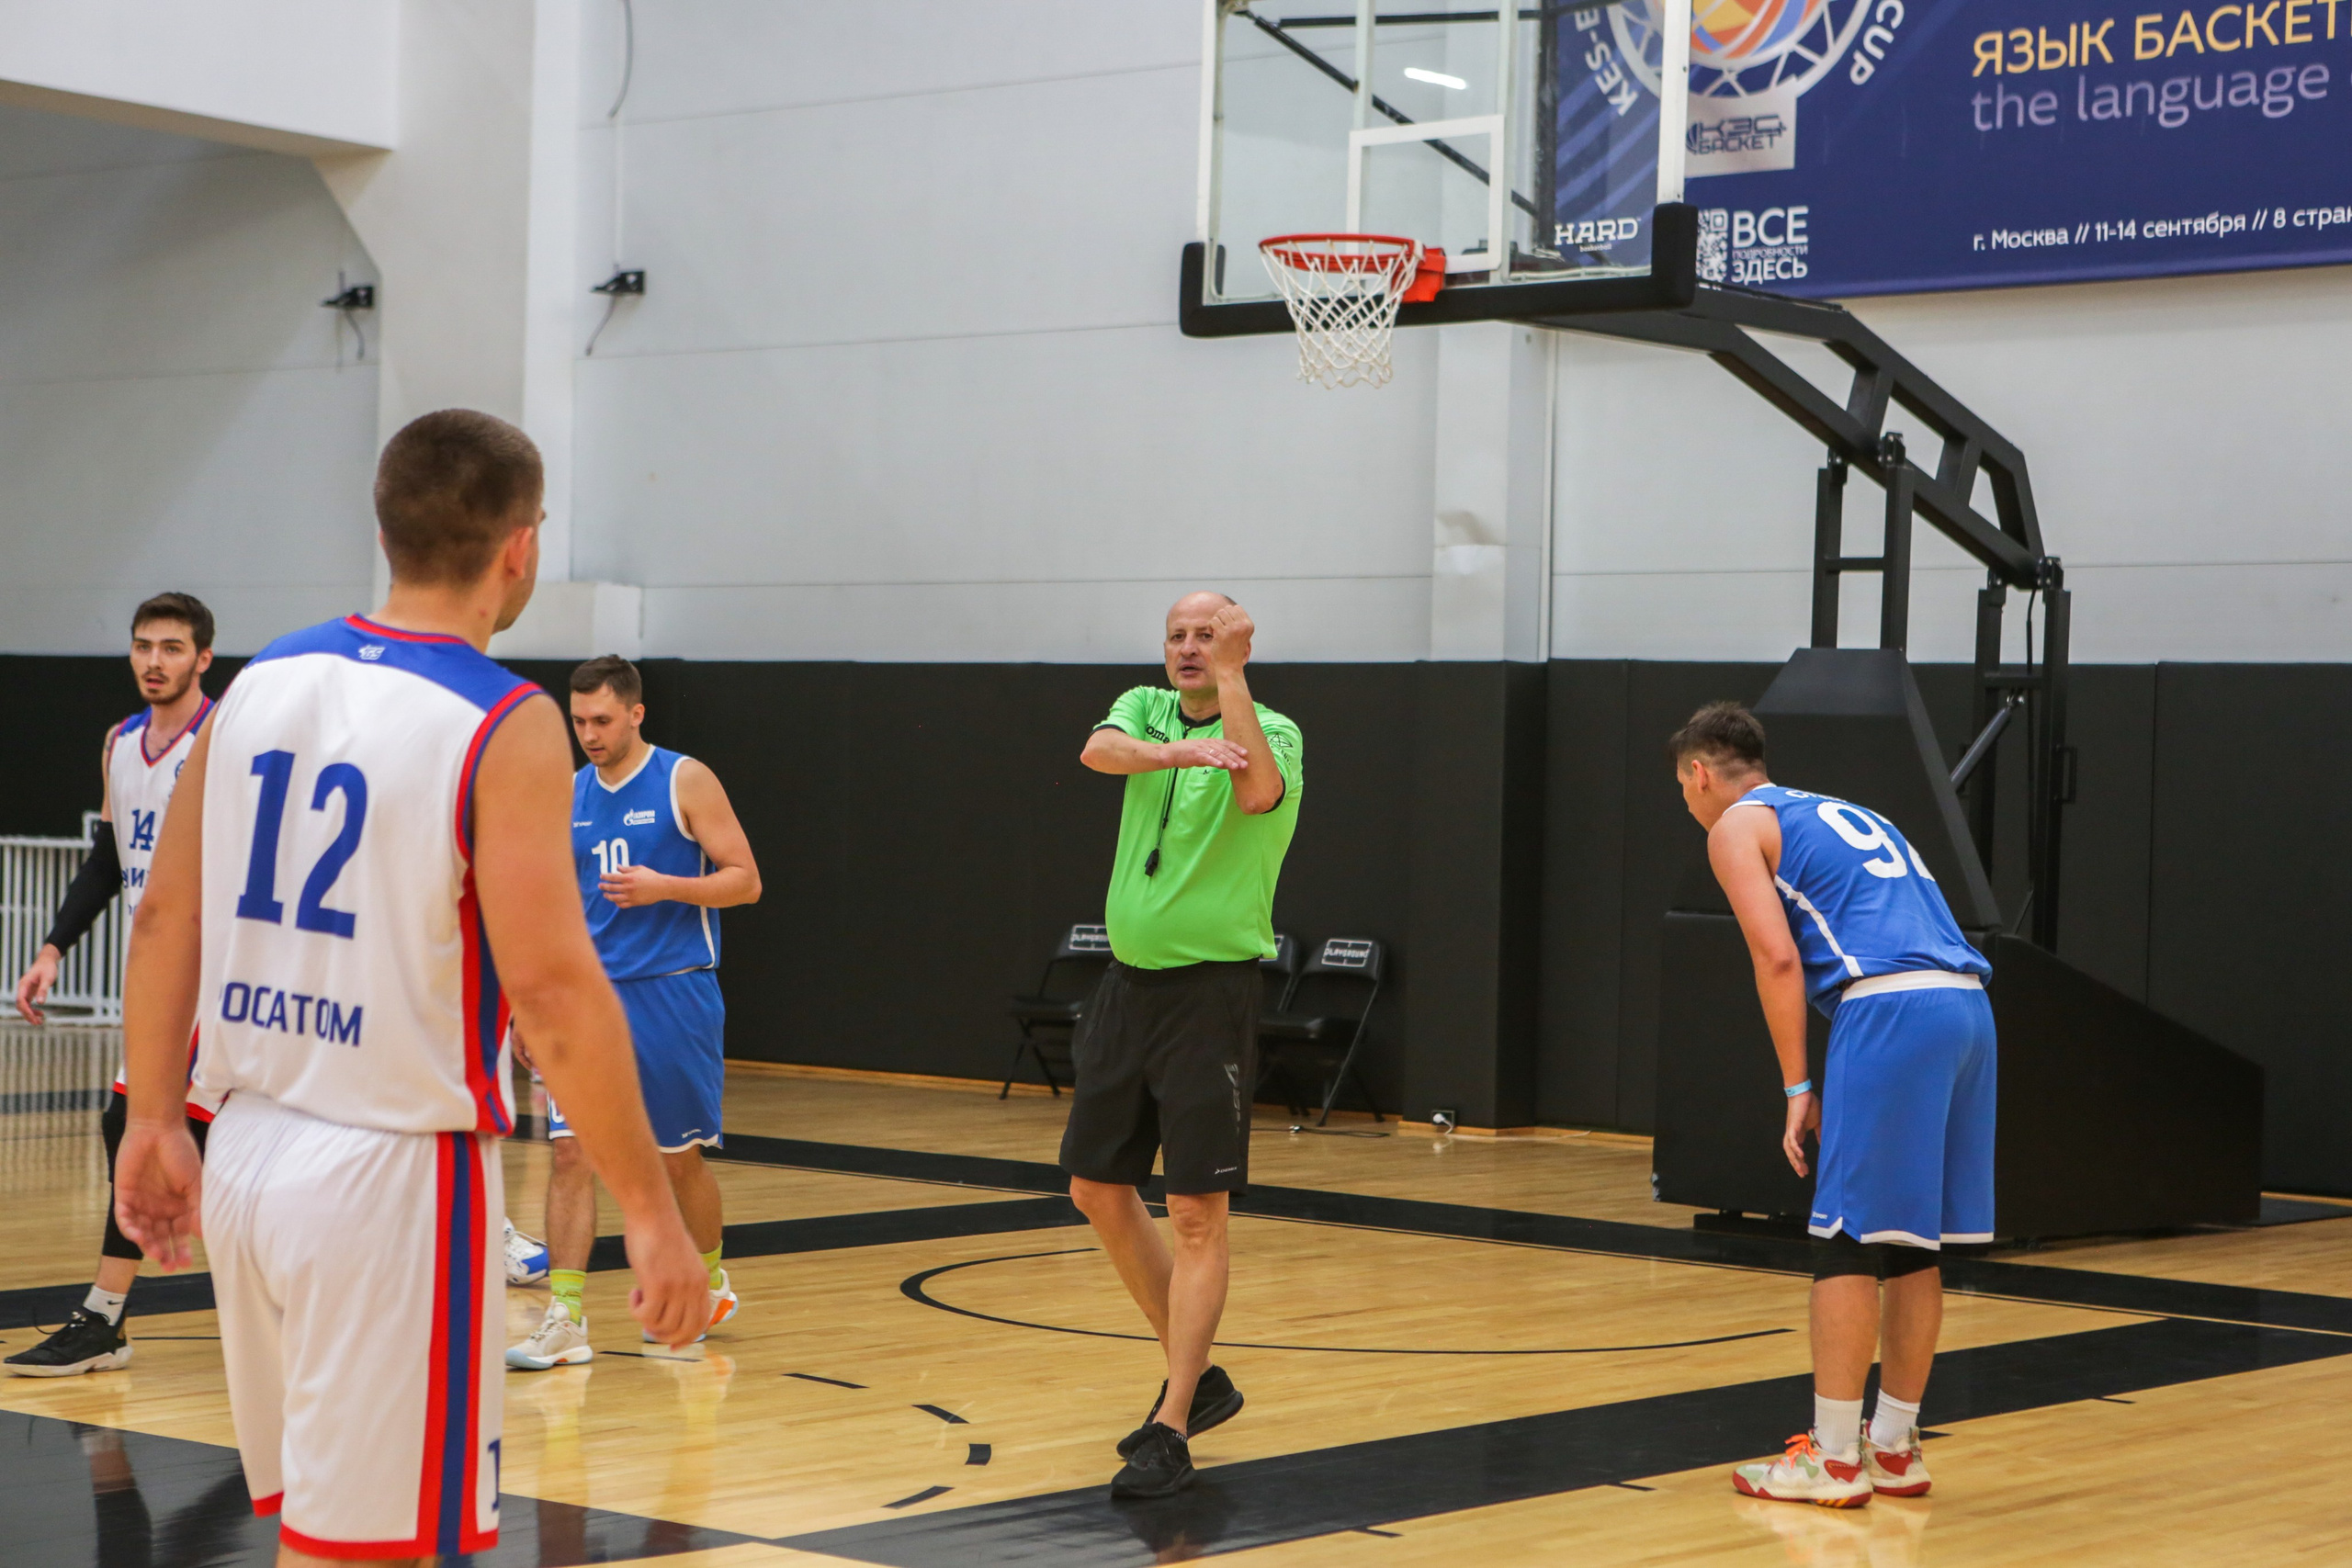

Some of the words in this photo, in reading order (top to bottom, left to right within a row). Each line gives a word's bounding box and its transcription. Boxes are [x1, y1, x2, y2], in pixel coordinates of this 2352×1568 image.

[1849, 0, 1905, 85] CUP
[1973, 18, 2115, 77] ЯЗЫК
[2134, 0, 2352, 61] БАСКЕТ
[1972, 83, 2058, 131] the
[2077, 62, 2330, 129] language
[1700, 133, 1778, 154] БАСКЕТ
[1555, 218, 1638, 245] HARD
[1579, 243, 1612, 253] basketball
[1732, 206, 1808, 248] ВСЕ
[1973, 233, 1985, 251] г.
[1992, 227, 2069, 250] Москва
[2095, 219, 2137, 242] 11-14
[2143, 210, 2245, 238] сентября
[2273, 207, 2286, 229] 8
[1731, 256, 1808, 285] ЗДЕСЬ
[1733, 245, 1808, 260] ПОДРОБНОСТИ
[1146, 723, 1170, 744] oma
[129, 808, 155, 852] 14
[237, 749, 368, 940] 12
[591, 838, 630, 875] 10
[219, 981, 363, 1047] ОСАТОМ
